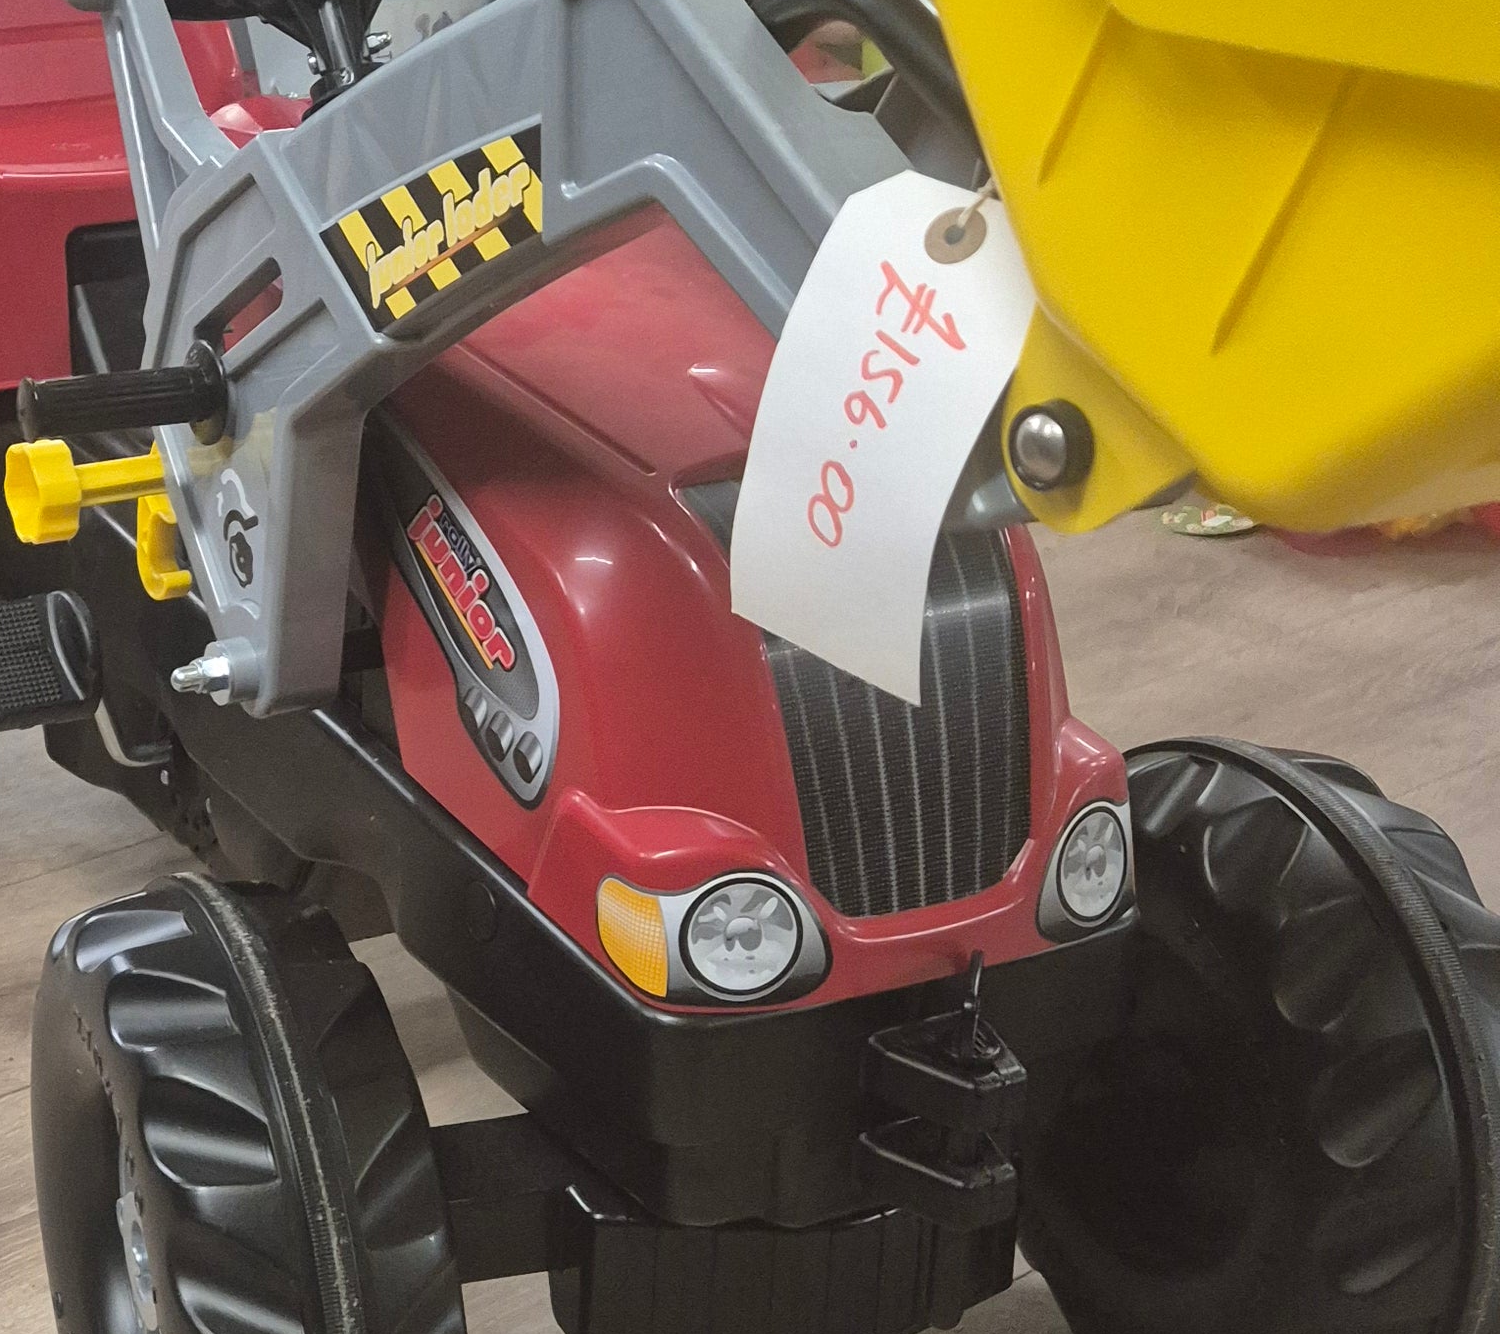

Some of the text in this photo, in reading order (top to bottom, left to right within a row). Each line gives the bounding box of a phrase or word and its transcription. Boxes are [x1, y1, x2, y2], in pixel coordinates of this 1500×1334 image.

[366, 218, 444, 310] junior
[808, 261, 967, 547] £156.00
[407, 494, 516, 671] junior
[439, 513, 482, 574] rolly
